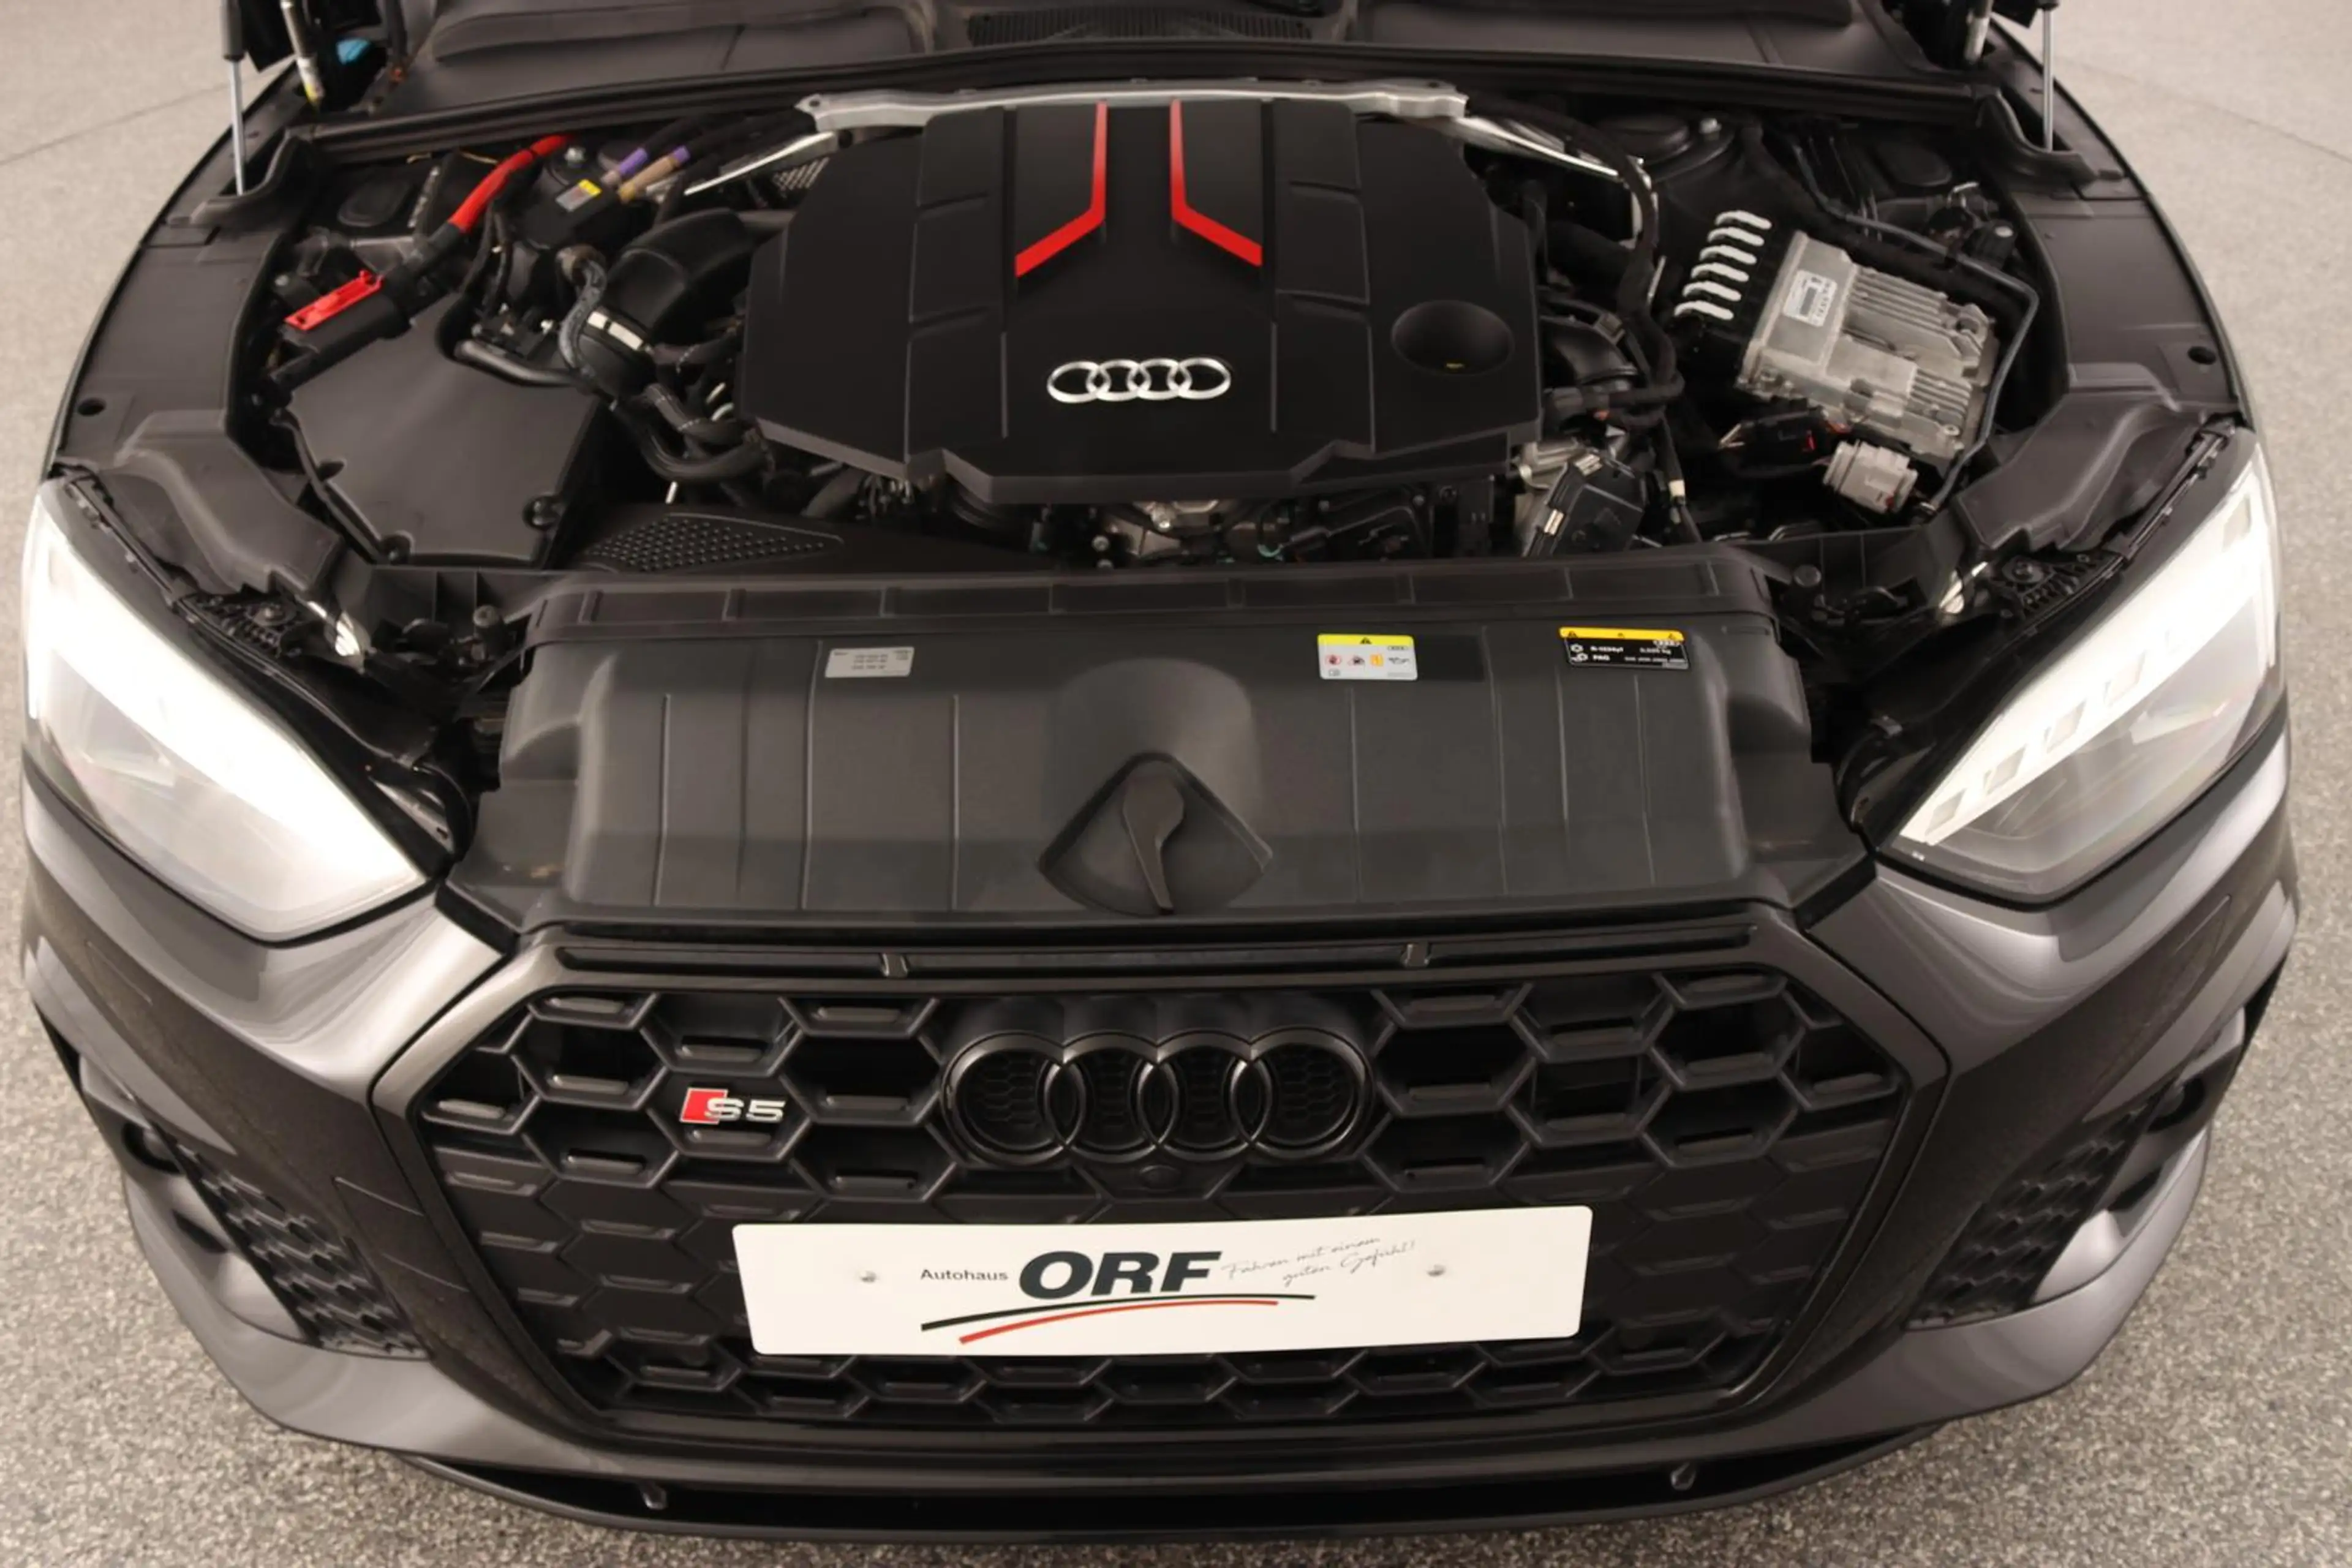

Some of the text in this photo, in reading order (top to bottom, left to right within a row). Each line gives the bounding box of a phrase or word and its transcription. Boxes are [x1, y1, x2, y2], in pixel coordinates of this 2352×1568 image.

[704, 1097, 786, 1123] S5
[921, 1251, 1223, 1299] Autohaus ORF
